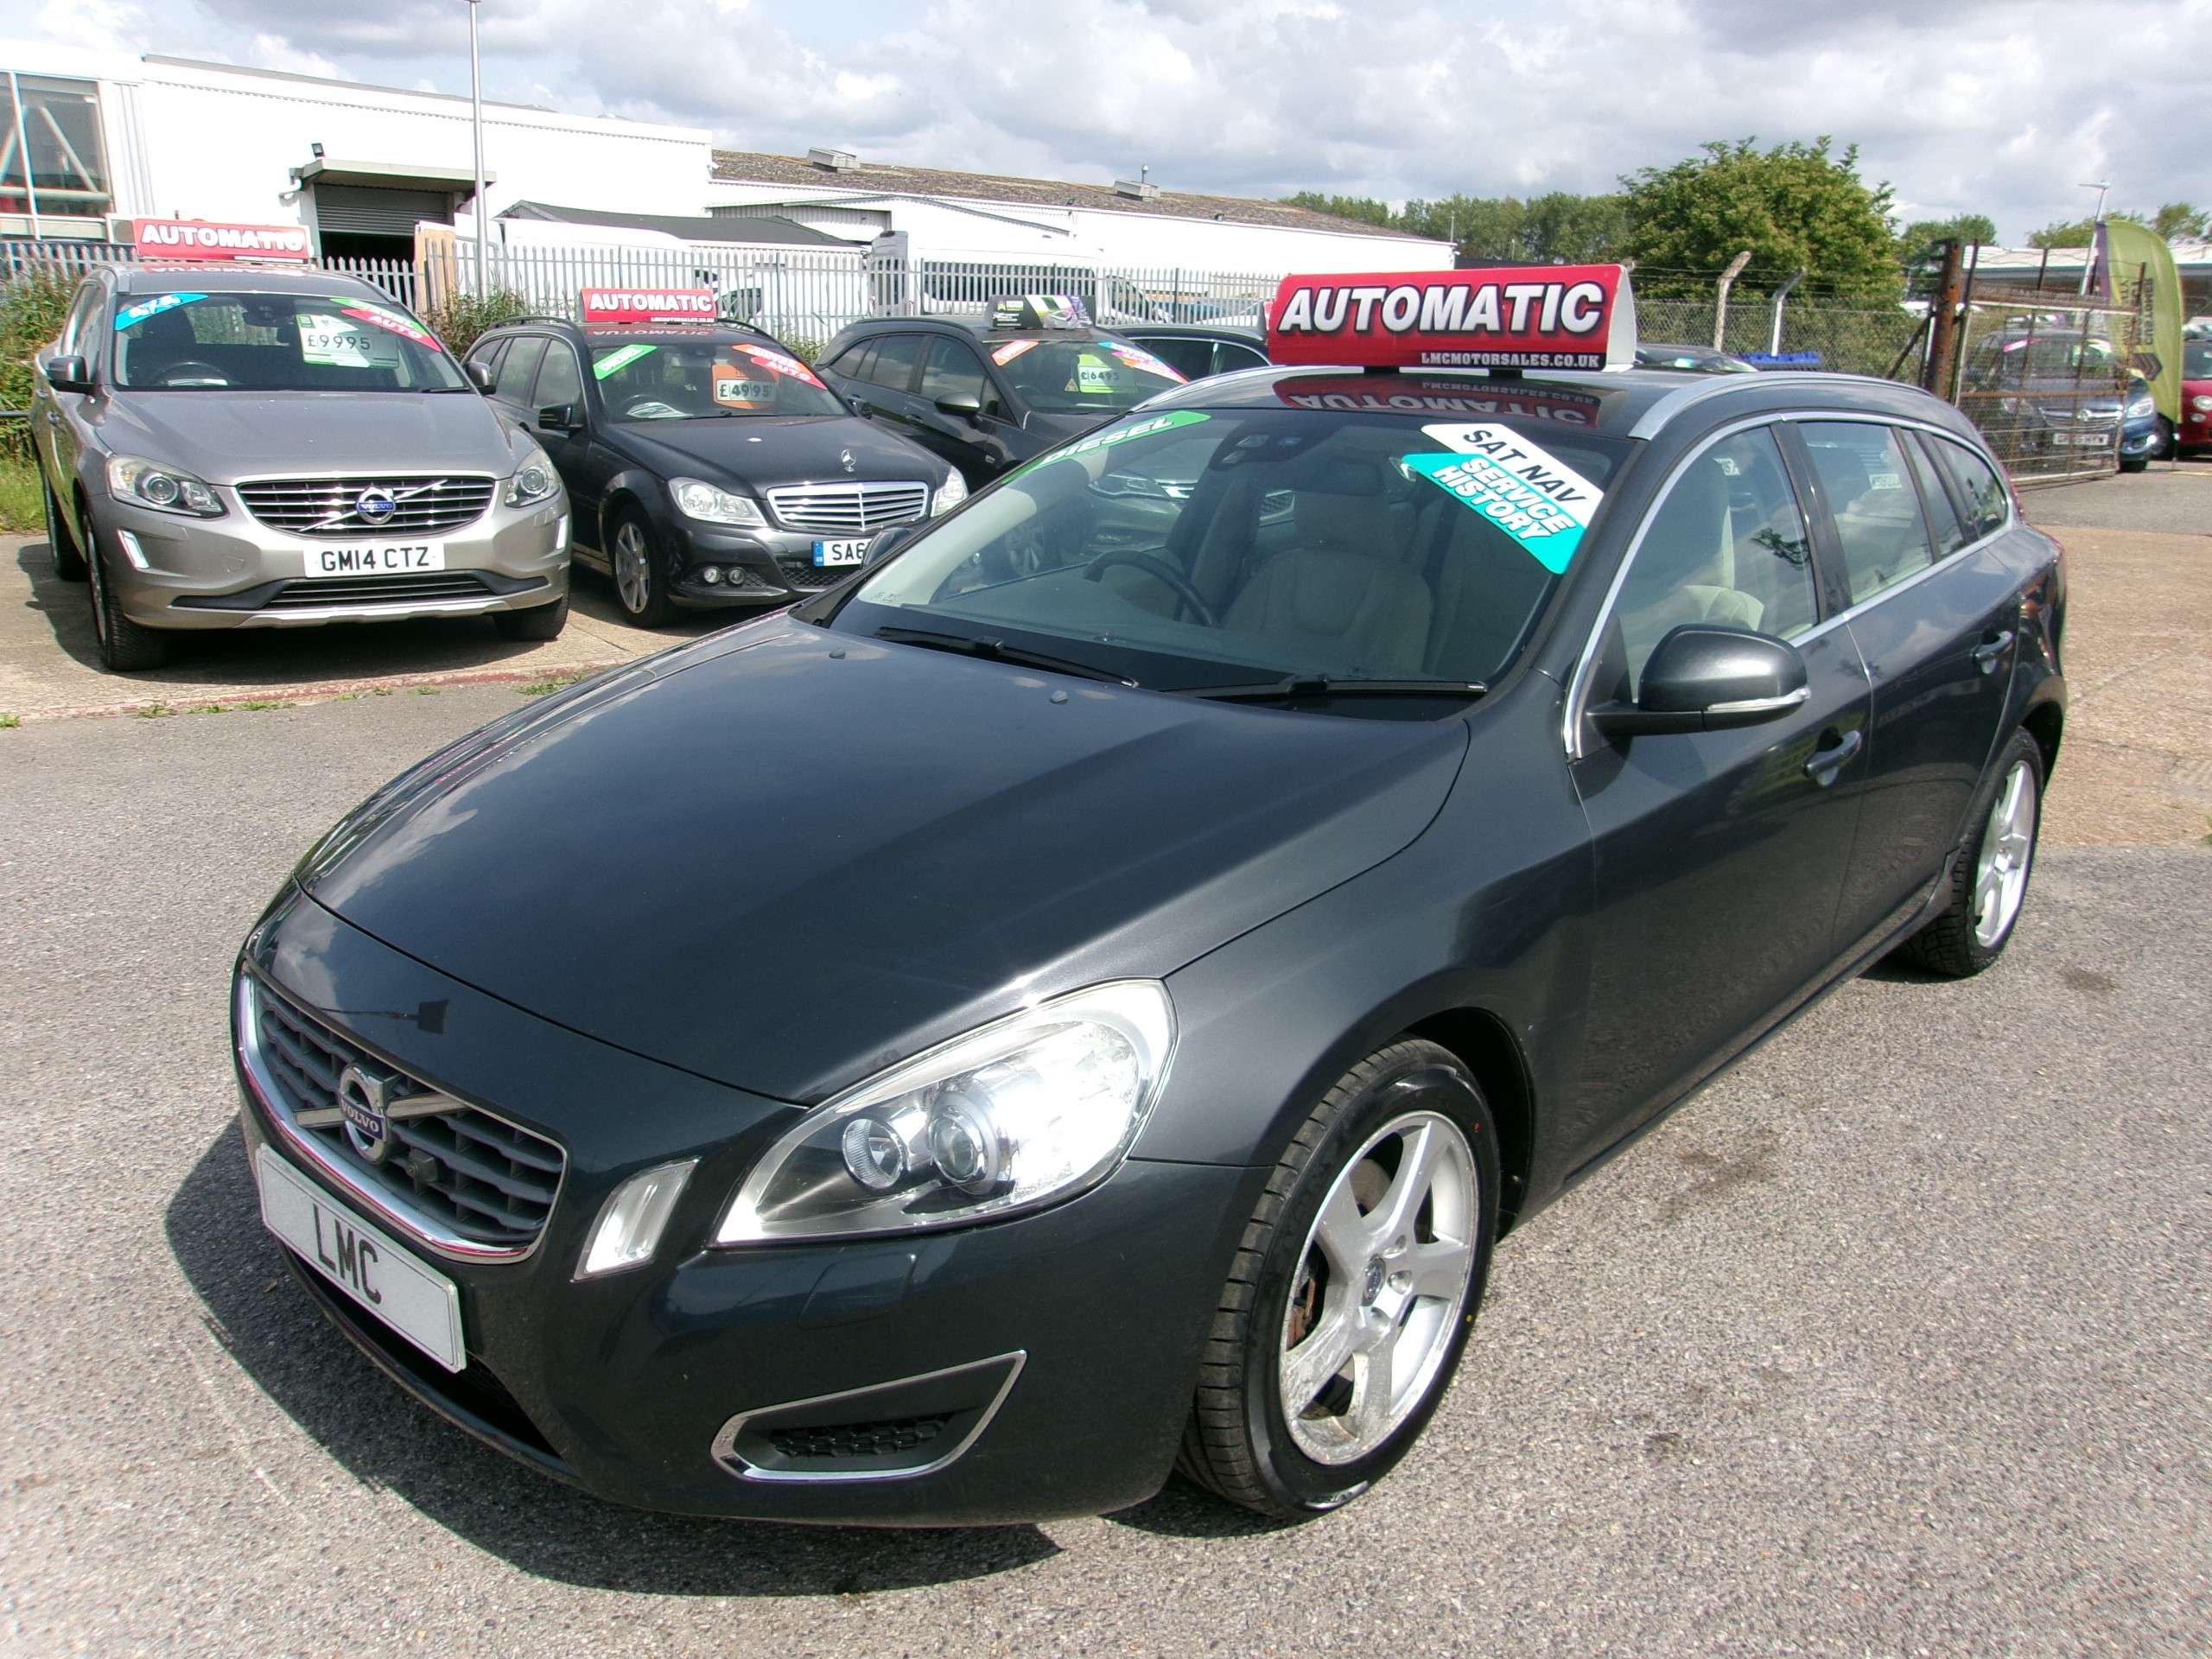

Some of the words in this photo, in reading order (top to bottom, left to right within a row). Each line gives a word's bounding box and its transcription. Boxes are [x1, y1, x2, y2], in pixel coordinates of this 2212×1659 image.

[141, 224, 303, 251] AUTOMATIC
[589, 293, 712, 312] AUTOMATIC
[1278, 283, 1603, 334] AUTOMATIC
[307, 334, 372, 350] £9995
[367, 315, 423, 339] AUTO
[1421, 352, 1599, 367] LMCMOTORSALES.CO.UK
[1041, 417, 1174, 465] DIESEL
[1463, 429, 1528, 462] SAT
[1517, 465, 1587, 502] NAV
[1431, 465, 1553, 540] HISTORY
[1459, 457, 1576, 535] SERVICE
[321, 550, 377, 572] GM14
[384, 546, 429, 569] CTZ
[340, 1100, 380, 1133] VOLVO
[313, 1203, 382, 1305] LMC
